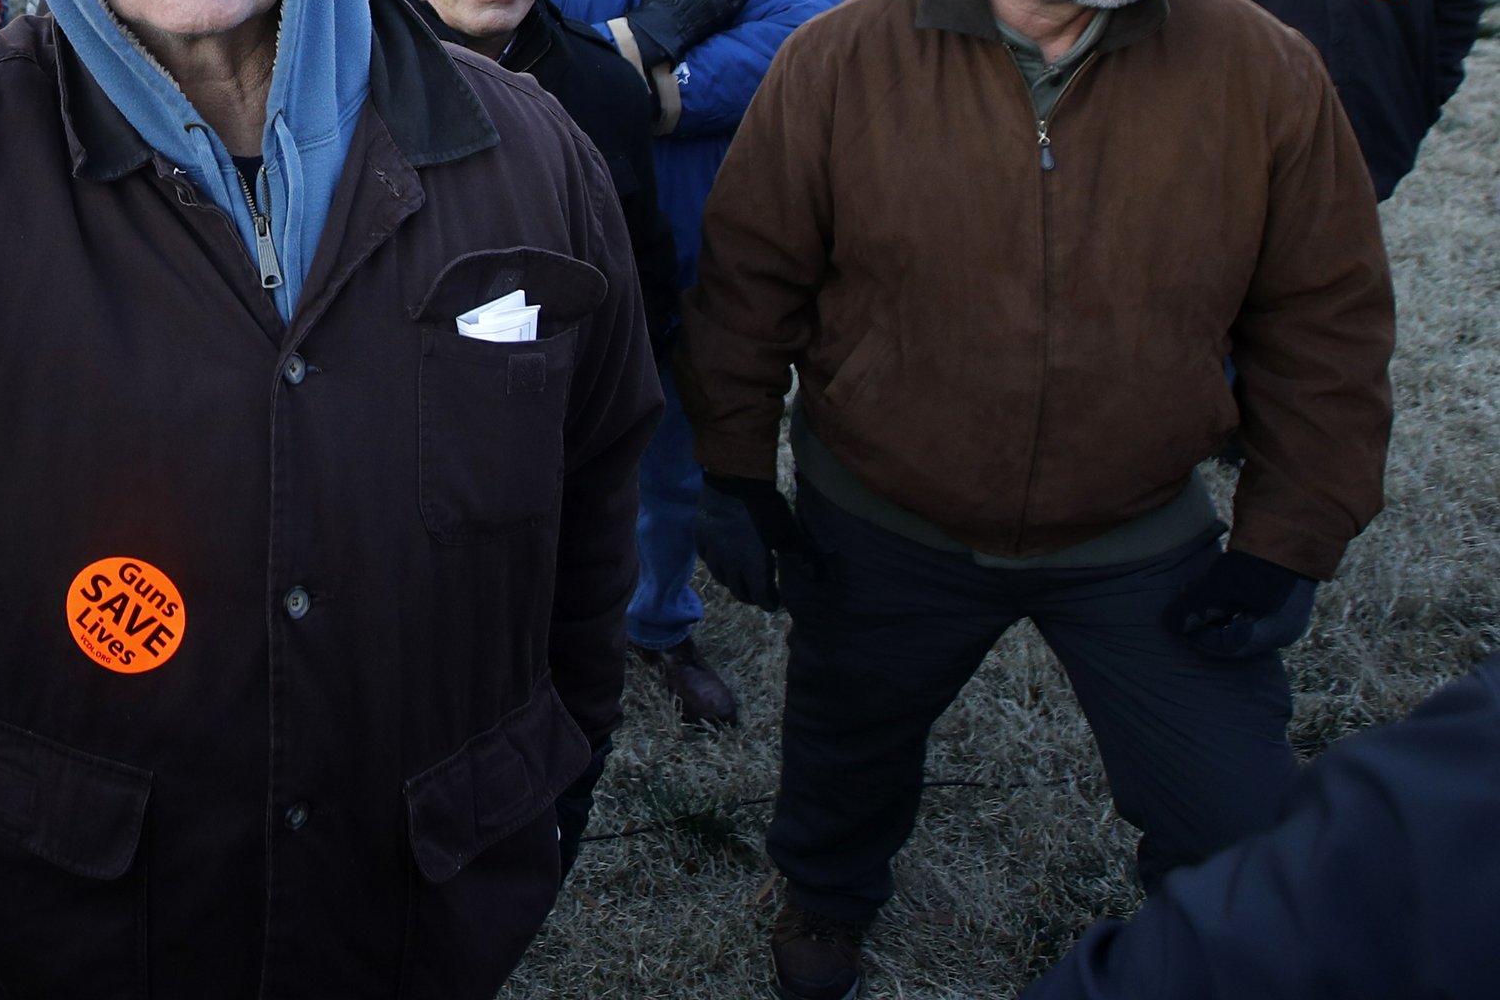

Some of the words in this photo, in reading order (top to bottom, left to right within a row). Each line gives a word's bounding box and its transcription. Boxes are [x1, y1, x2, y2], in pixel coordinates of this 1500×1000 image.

[80, 574, 175, 658] SAVE
[118, 562, 178, 617] Guns
[76, 607, 136, 665] Lives
[80, 634, 111, 664] VCDL.ORG
